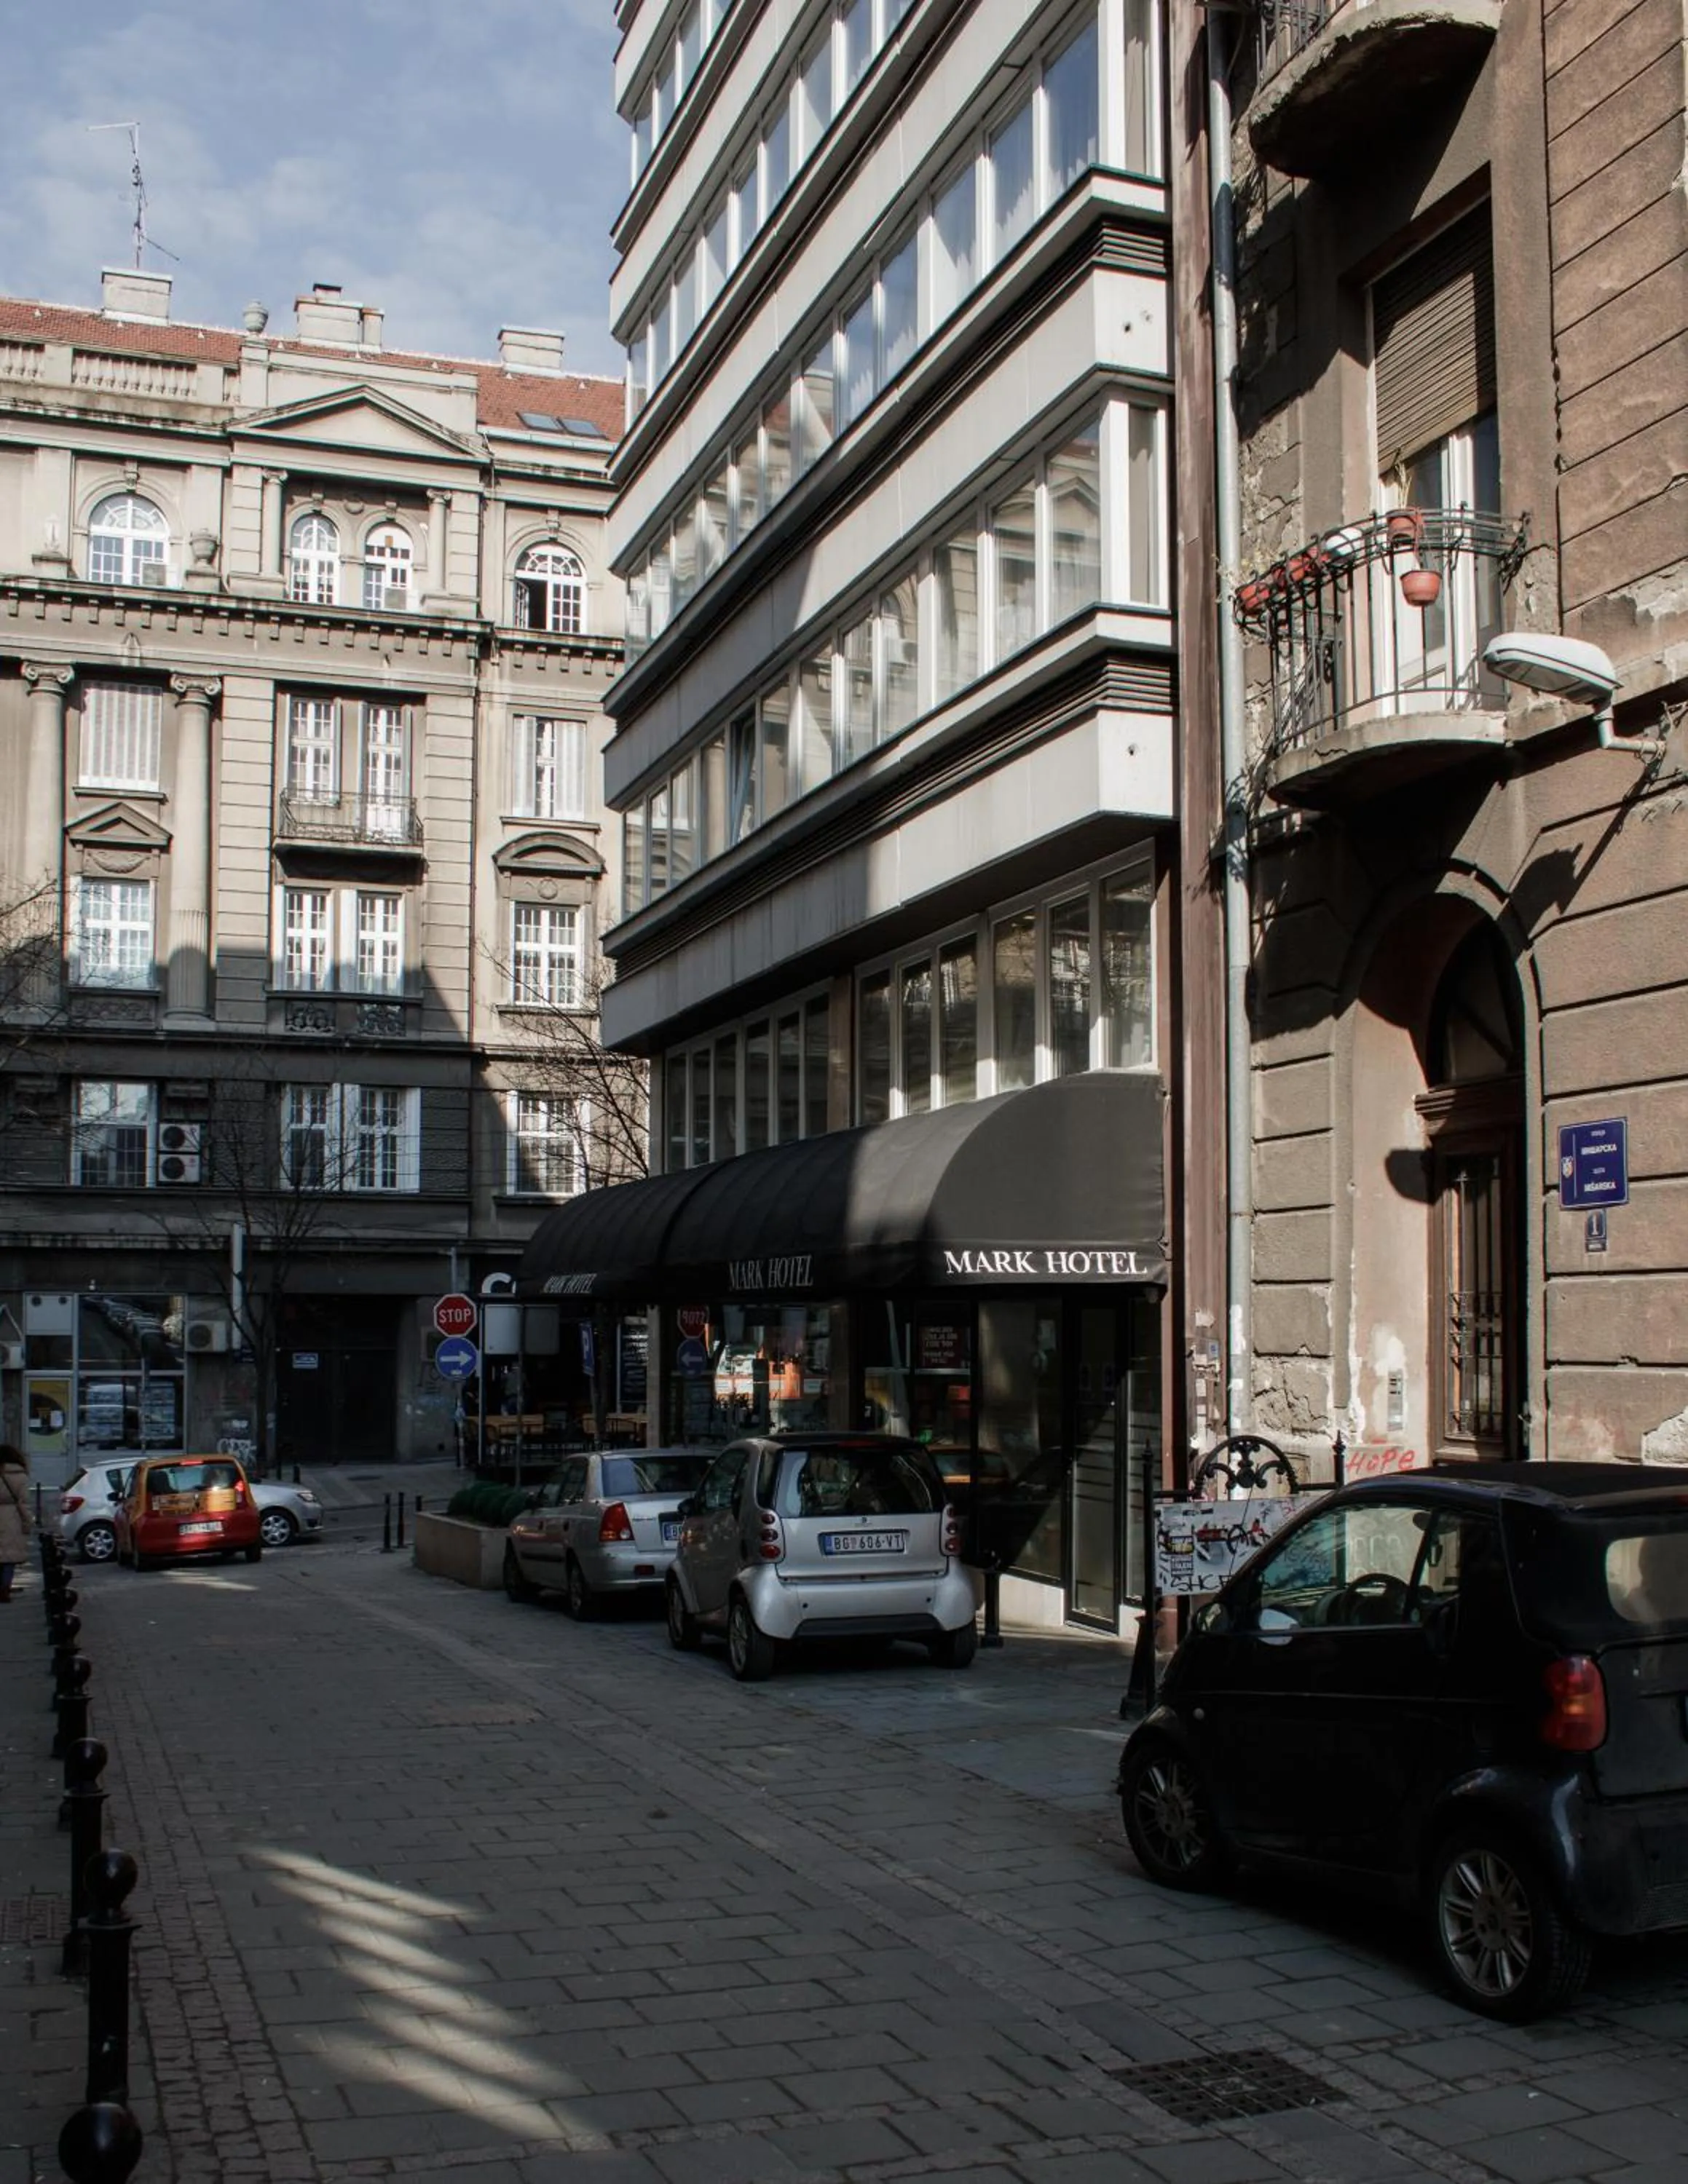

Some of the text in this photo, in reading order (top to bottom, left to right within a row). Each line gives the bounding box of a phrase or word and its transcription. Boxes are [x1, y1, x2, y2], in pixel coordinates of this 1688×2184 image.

[1592, 1214, 1598, 1235] 1
[729, 1254, 813, 1291] MARK HOTEL
[944, 1251, 1148, 1274] MARK HOTEL
[438, 1308, 472, 1324] STOP
[834, 1537, 851, 1550] BG
